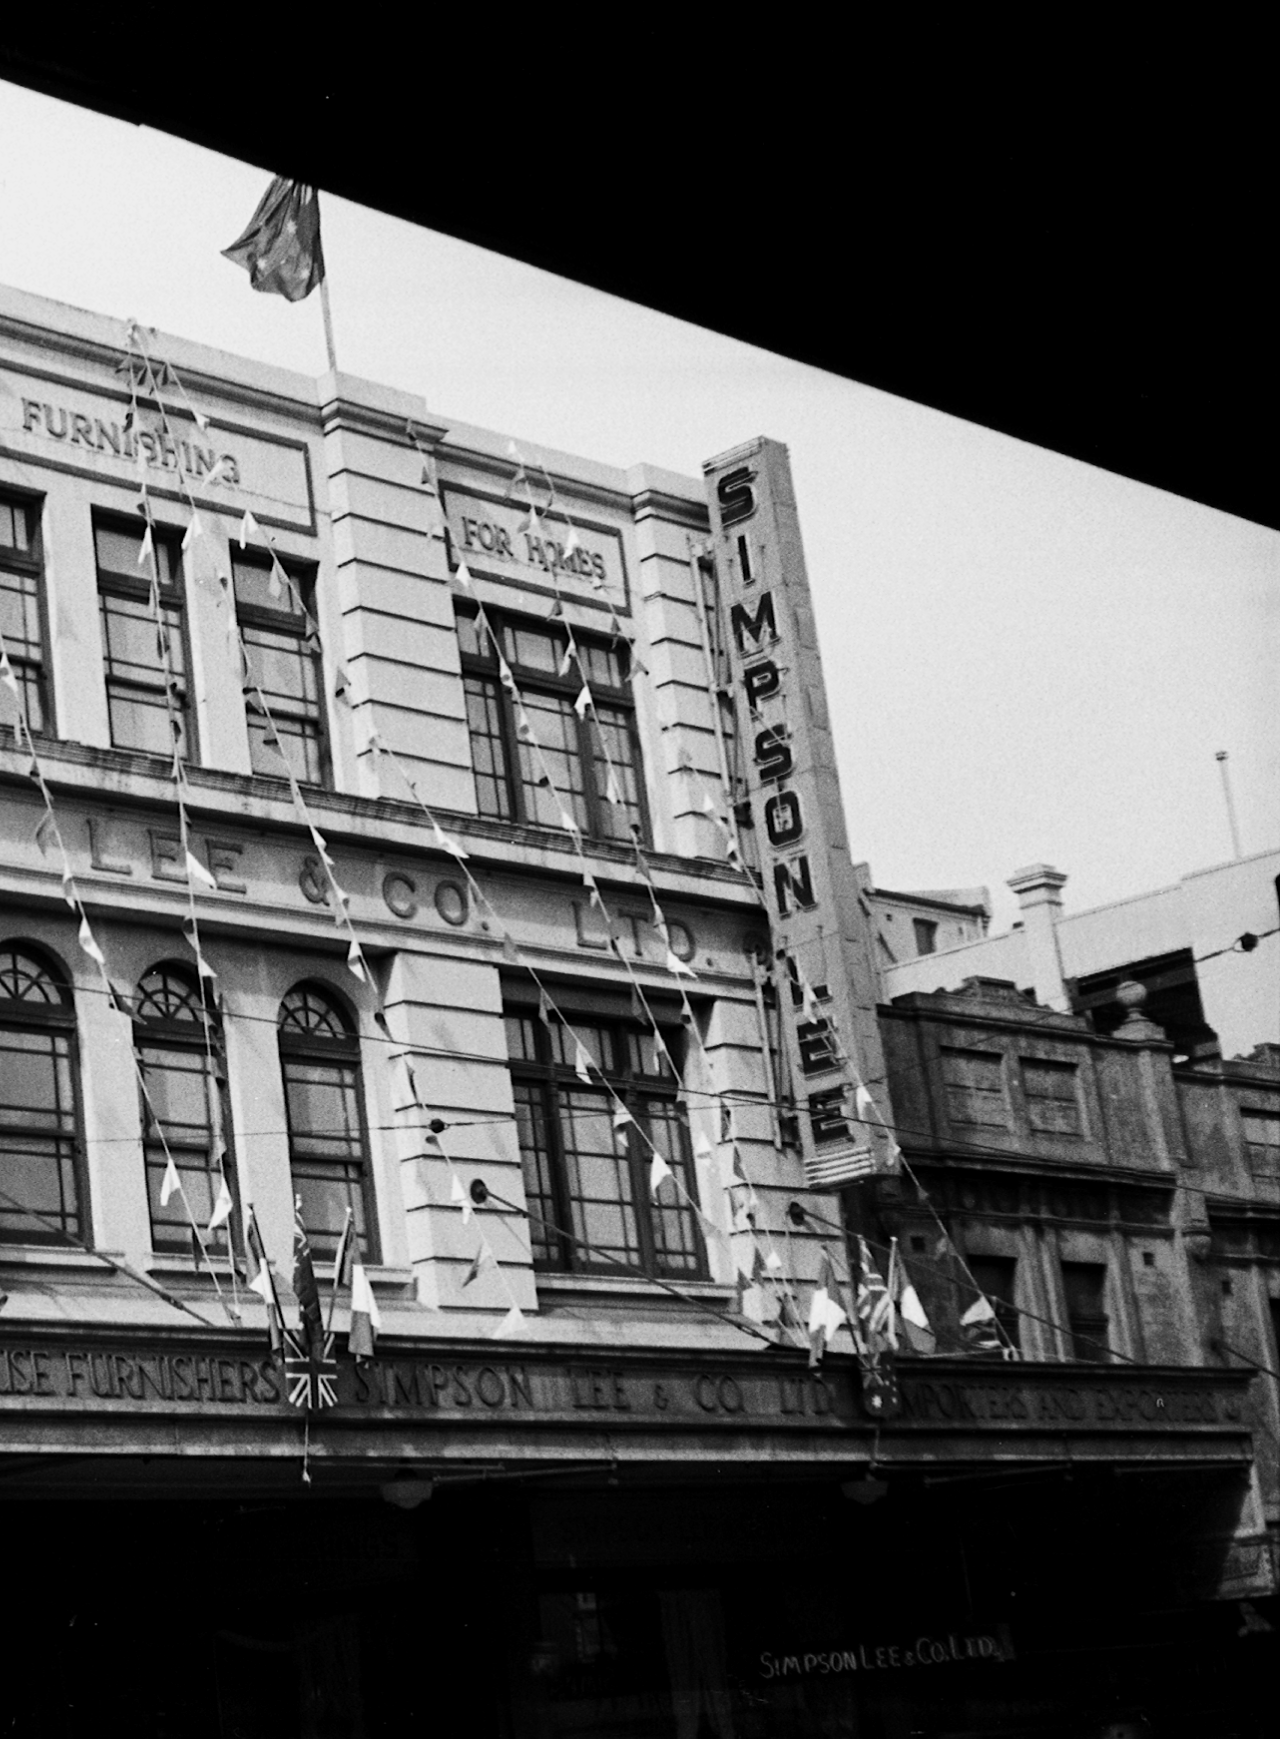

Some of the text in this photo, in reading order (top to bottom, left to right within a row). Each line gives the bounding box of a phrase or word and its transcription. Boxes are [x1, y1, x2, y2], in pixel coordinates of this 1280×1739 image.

[461, 516, 514, 557] FOR
[85, 818, 248, 895] LEE
[298, 855, 330, 907] &
[62, 1350, 282, 1405] FURNISHERS
[354, 1358, 535, 1408] SIMPSON
[571, 1369, 632, 1411] LEE
[759, 1651, 858, 1679] SIMPSON
